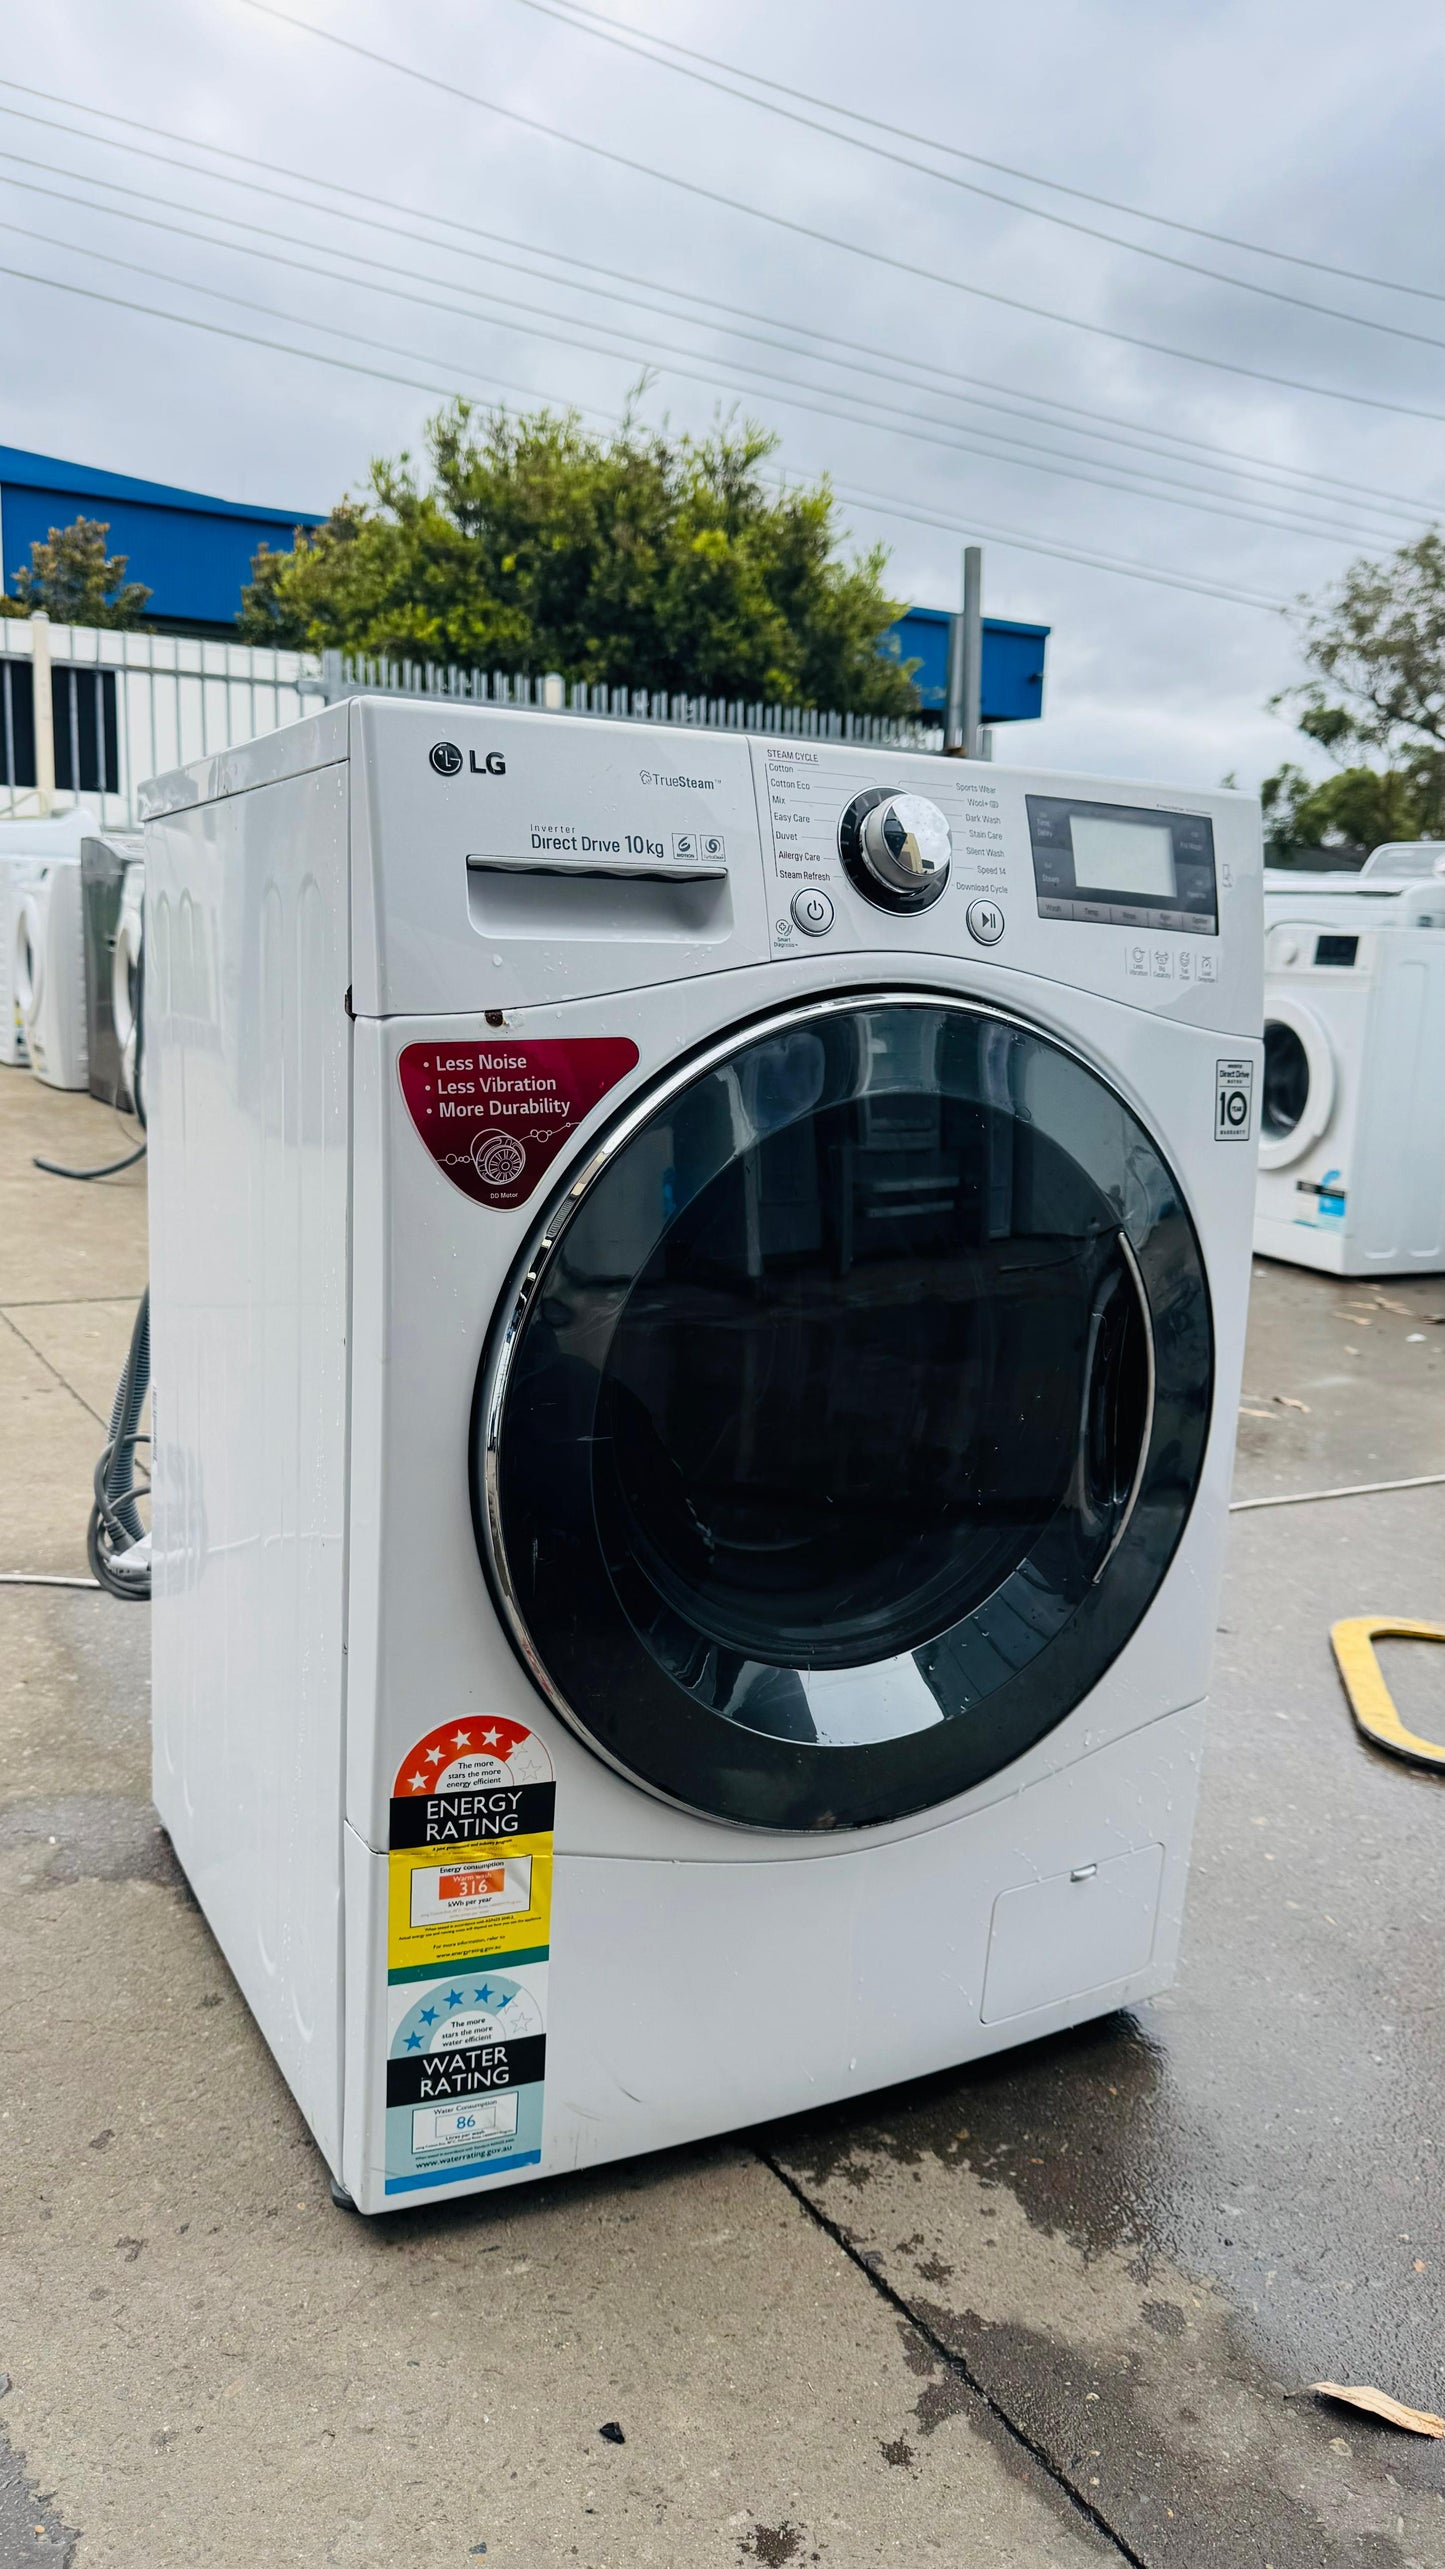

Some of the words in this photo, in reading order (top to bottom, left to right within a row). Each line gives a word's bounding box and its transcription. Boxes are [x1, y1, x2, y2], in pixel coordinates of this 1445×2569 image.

[767, 749, 795, 760] STEAM
[795, 752, 819, 762] CYCLE
[469, 750, 506, 775] LG
[769, 763, 794, 773] Cotton
[770, 778, 796, 789] Cotton
[796, 780, 811, 790] Eco
[956, 782, 978, 793] Sports
[979, 786, 997, 794] Wear
[772, 795, 786, 804] Mix
[774, 812, 792, 823] Easy
[793, 813, 811, 823] Care
[965, 813, 981, 822] Dark
[982, 815, 1001, 824] Wash
[530, 824, 576, 833] Inverter
[776, 830, 798, 841] Duvet
[968, 830, 987, 839] Stain
[987, 831, 1003, 840] Care
[531, 834, 578, 851] Direct
[581, 836, 620, 852] Drive
[779, 850, 803, 862] Allergy
[804, 852, 821, 861] Care
[966, 847, 985, 856] Silent
[986, 848, 1005, 858] Wash
[779, 869, 803, 879] Steam
[803, 871, 831, 881] Refresh
[977, 865, 998, 876] Speed
[956, 882, 990, 892] Download
[990, 884, 1009, 894] Cycle
[436, 1055, 475, 1071] Less
[478, 1053, 527, 1071] Noise
[1220, 1070, 1235, 1078] Direct
[1235, 1070, 1250, 1079] Drive
[437, 1078, 475, 1095] Less
[479, 1075, 557, 1094] Vibration
[439, 1101, 485, 1118] More
[489, 1098, 571, 1117] Durability
[1219, 1091, 1248, 1126] 10
[473, 1777, 501, 1786] efficient
[427, 1791, 523, 1820] ENERGY
[426, 1814, 519, 1842] RATING
[440, 1865, 462, 1874] Energy
[463, 1861, 505, 1871] consumption
[453, 1874, 474, 1882] Warm
[475, 1872, 493, 1880] wash
[459, 1879, 488, 1897] 316
[478, 1897, 493, 1905] year
[451, 2020, 465, 2028] The
[466, 2018, 486, 2026] more
[442, 2031, 459, 2039] stars
[473, 2026, 493, 2034] more
[442, 2039, 463, 2047] water
[464, 2034, 492, 2043] efficient
[423, 2046, 508, 2076] WATER
[421, 2067, 510, 2098] RATING
[434, 2107, 455, 2115] Water
[456, 2100, 498, 2111] Consumption
[457, 2114, 476, 2129] 86
[415, 2145, 513, 2168] www.waterrating.gov.au
